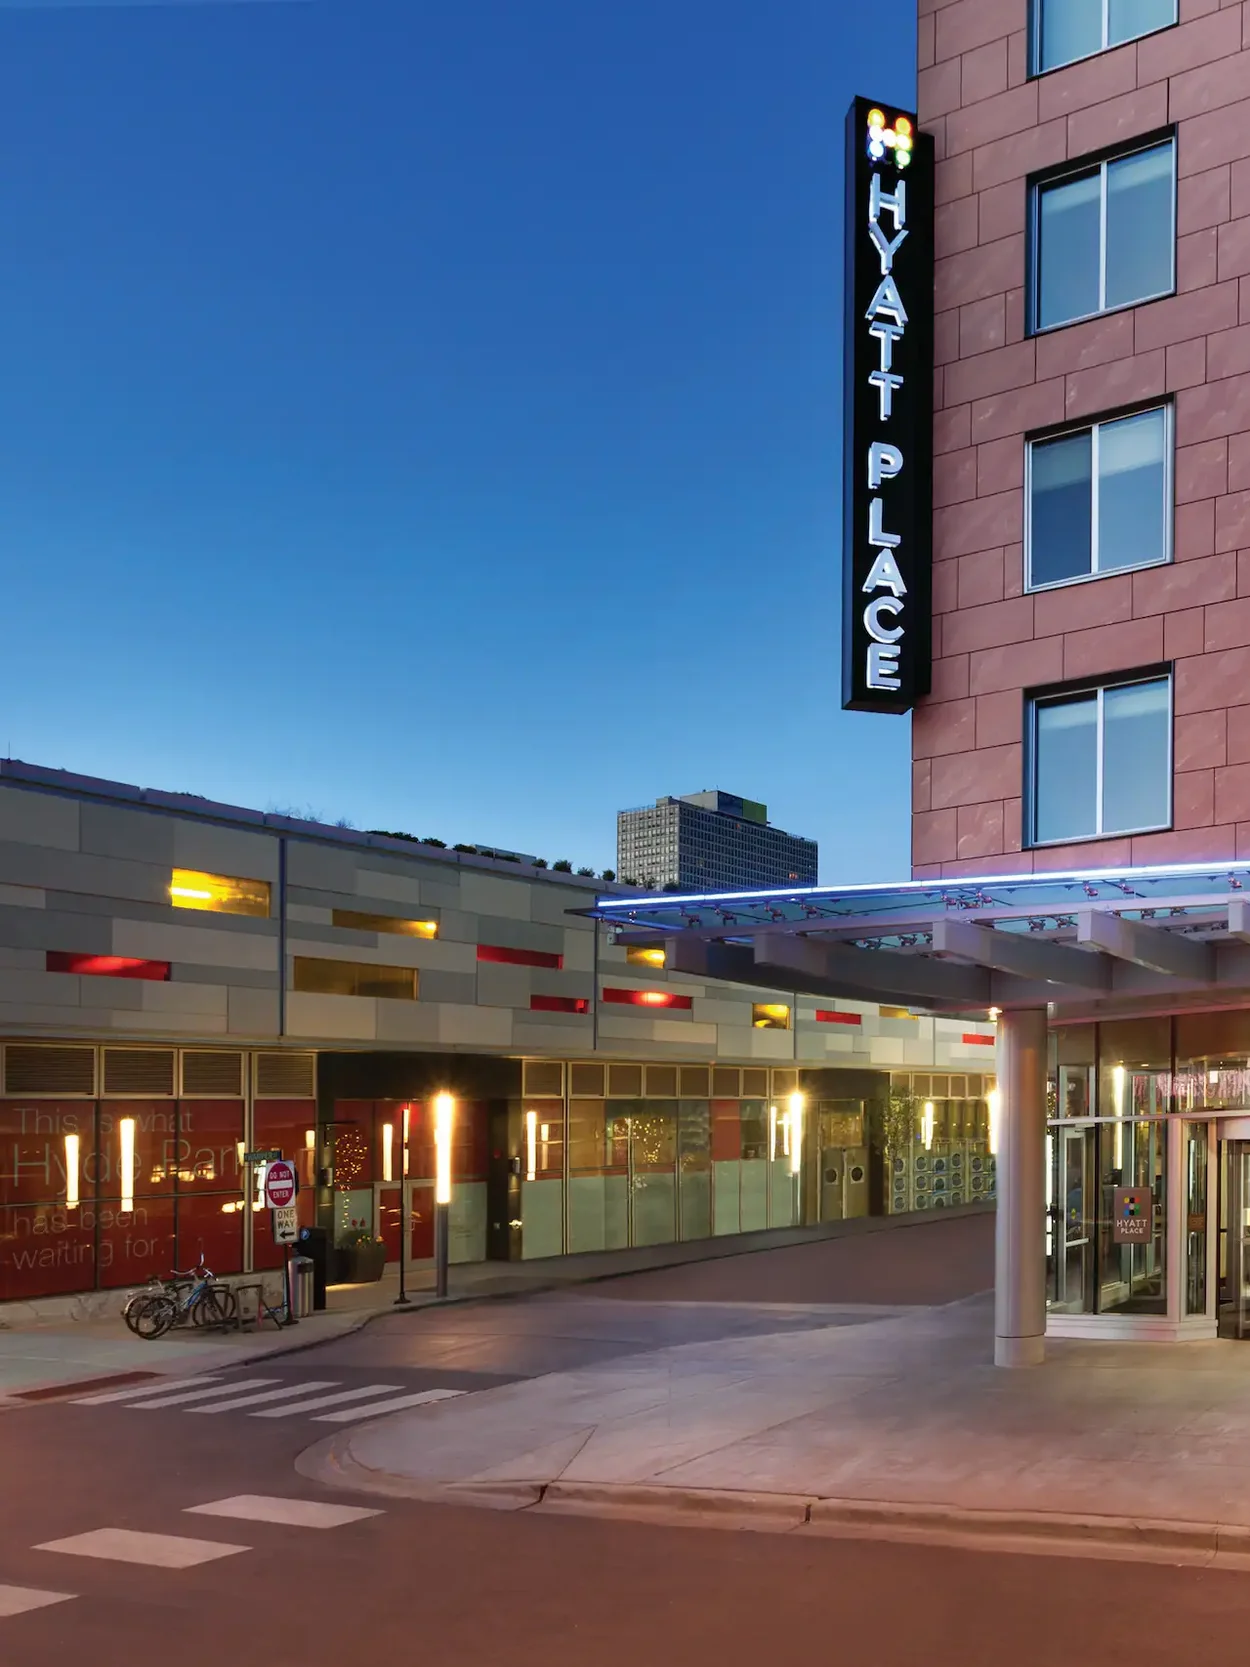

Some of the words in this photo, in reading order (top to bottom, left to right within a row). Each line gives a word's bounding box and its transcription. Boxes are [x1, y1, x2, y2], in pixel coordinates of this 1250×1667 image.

[865, 172, 909, 421] HYATT
[861, 440, 908, 691] PLACE
[13, 1107, 79, 1135] This
[270, 1171, 277, 1180] DO
[280, 1170, 290, 1179] NOT
[273, 1190, 290, 1199] ENTER
[277, 1209, 295, 1220] ONE
[13, 1210, 67, 1236] has
[80, 1206, 148, 1231] been
[277, 1219, 295, 1230] WAY
[1116, 1219, 1148, 1228] HYATT
[1120, 1227, 1144, 1235] PLACE
[12, 1238, 114, 1271] waiting
